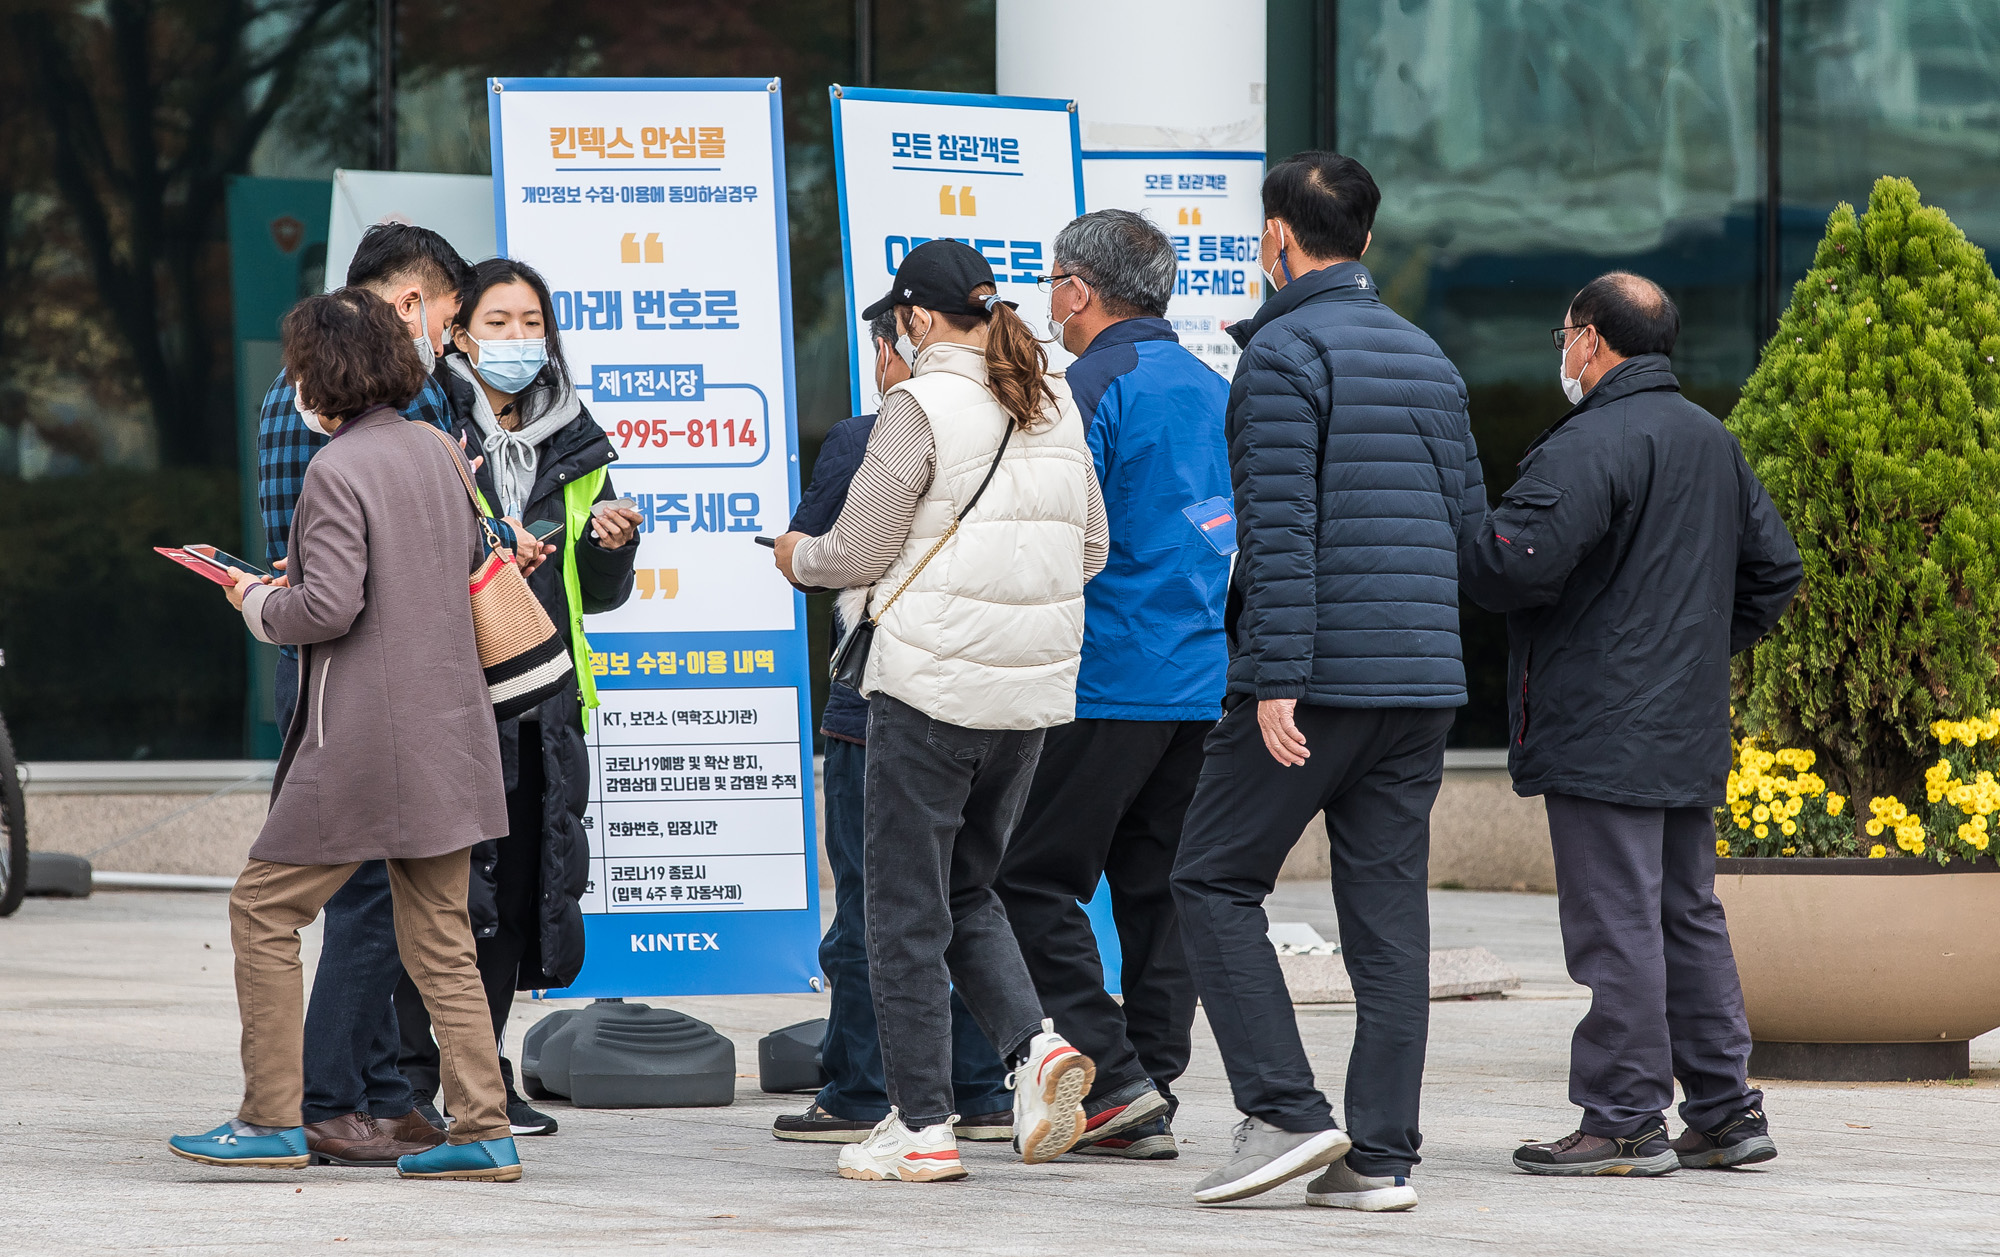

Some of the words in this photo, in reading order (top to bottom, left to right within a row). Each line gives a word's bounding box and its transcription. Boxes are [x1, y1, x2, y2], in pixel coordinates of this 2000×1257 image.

[550, 127, 635, 159] 킨텍스
[641, 126, 726, 159] 안심콜
[892, 132, 932, 159] 모든
[937, 134, 1020, 164] 참관객은
[1145, 174, 1173, 190] 모든
[1178, 174, 1227, 190] 참관객은
[521, 186, 582, 203] 개인정보
[585, 185, 665, 203] 수집·이용에
[668, 185, 758, 203] 동의하실경우
[552, 290, 623, 331] 아래
[633, 288, 740, 331] 번호로
[598, 369, 698, 397] 제1전시장
[589, 652, 631, 676] 정보
[636, 651, 728, 675] 수집·이용
[733, 650, 775, 674] 내역
[603, 711, 627, 728] KT,
[630, 711, 668, 726] 보건소
[672, 708, 758, 726] (역학조사기관)
[605, 756, 685, 772] 코로나19예방
[688, 756, 700, 771] 및
[704, 755, 730, 771] 확산
[733, 754, 763, 771] 방지,
[606, 777, 657, 792] 감염상태
[660, 775, 711, 791] 모니터링
[714, 775, 727, 791] 및
[730, 775, 768, 790] 감염원
[771, 774, 797, 790] 추적
[608, 821, 664, 838] 전화번호,
[667, 820, 718, 836] 입장시간
[611, 866, 666, 881] 코로나19
[668, 865, 706, 880] 종료시
[612, 886, 643, 903] (입력
[646, 886, 667, 901] 4주
[670, 885, 683, 901] 후
[686, 883, 742, 901] 자동삭제)
[631, 932, 720, 953] KINTEX
